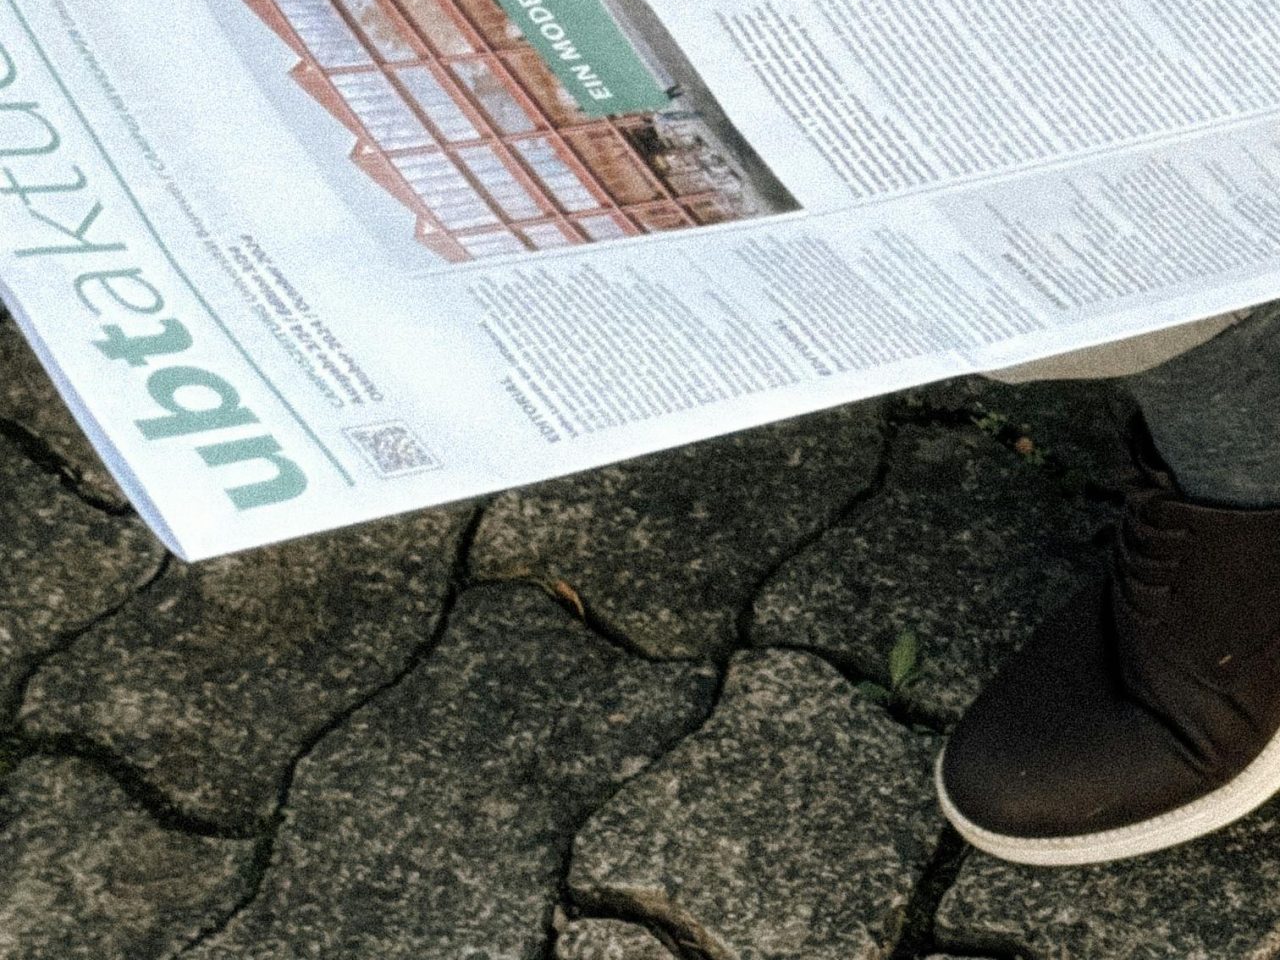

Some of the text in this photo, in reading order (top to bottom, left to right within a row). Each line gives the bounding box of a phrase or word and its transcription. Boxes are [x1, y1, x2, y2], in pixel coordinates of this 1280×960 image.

[570, 61, 613, 102] EIN
[0, 43, 308, 512] ubtaktu
[500, 375, 561, 443] EDITORIAL
